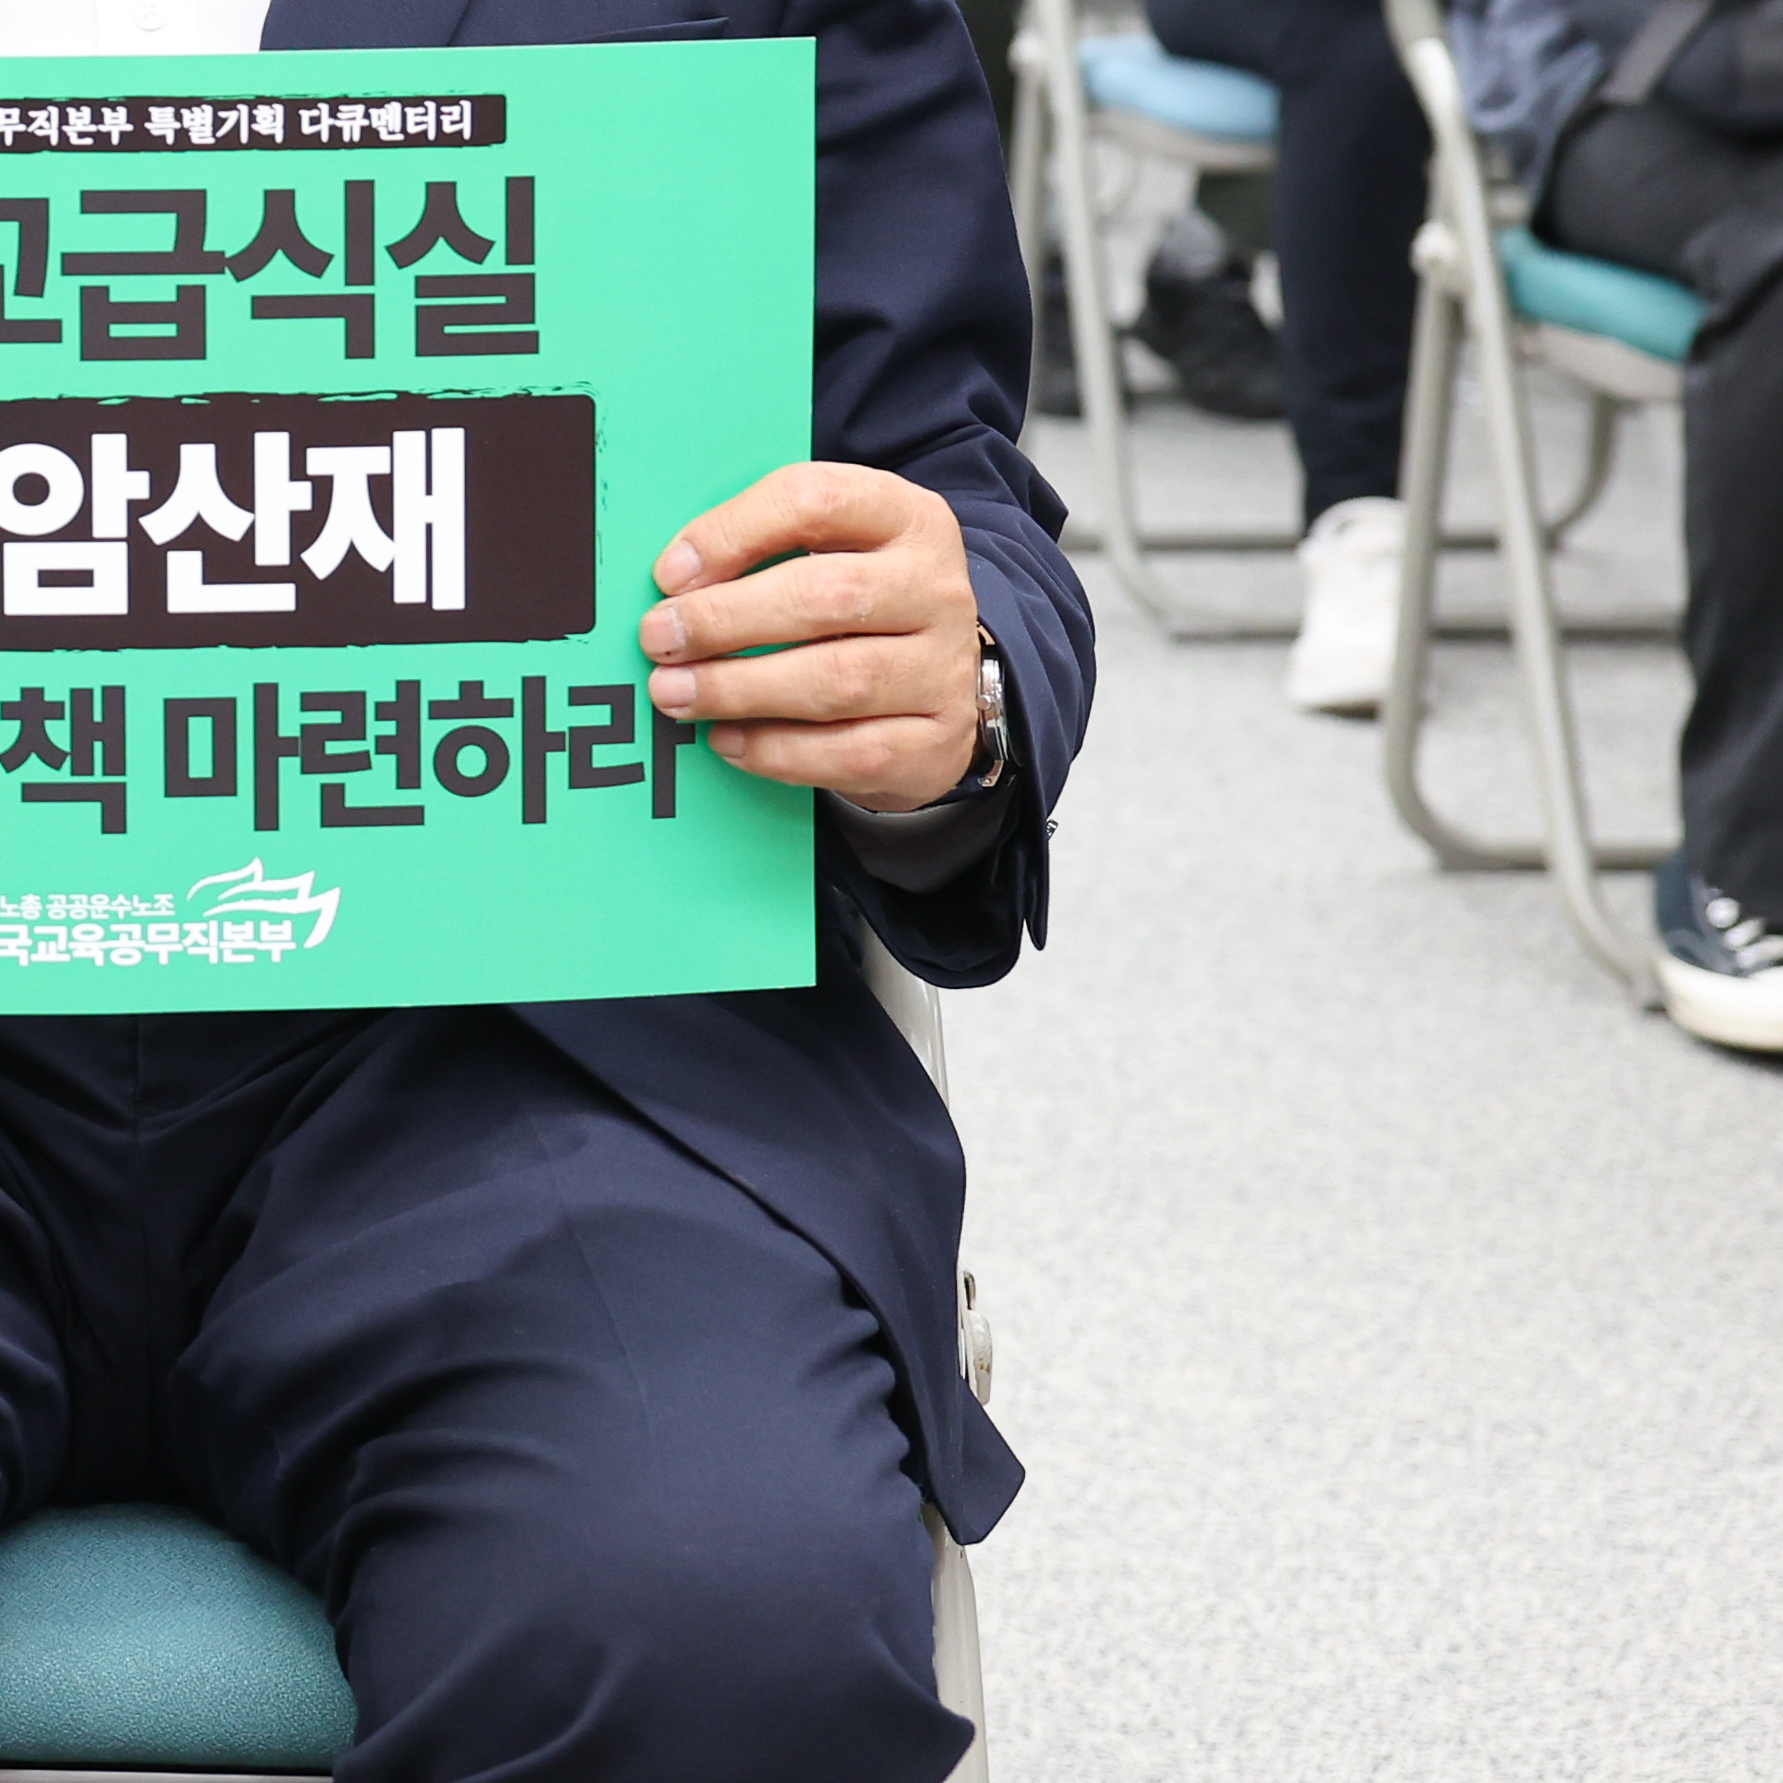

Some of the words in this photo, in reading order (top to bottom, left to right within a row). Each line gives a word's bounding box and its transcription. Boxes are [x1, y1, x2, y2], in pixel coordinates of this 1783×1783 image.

[144, 103, 285, 145] 특별기획
[297, 100, 474, 143] 다큐멘터리
[163, 675, 697, 833] 마련하라
[46, 893, 176, 920] 공공운수노조
